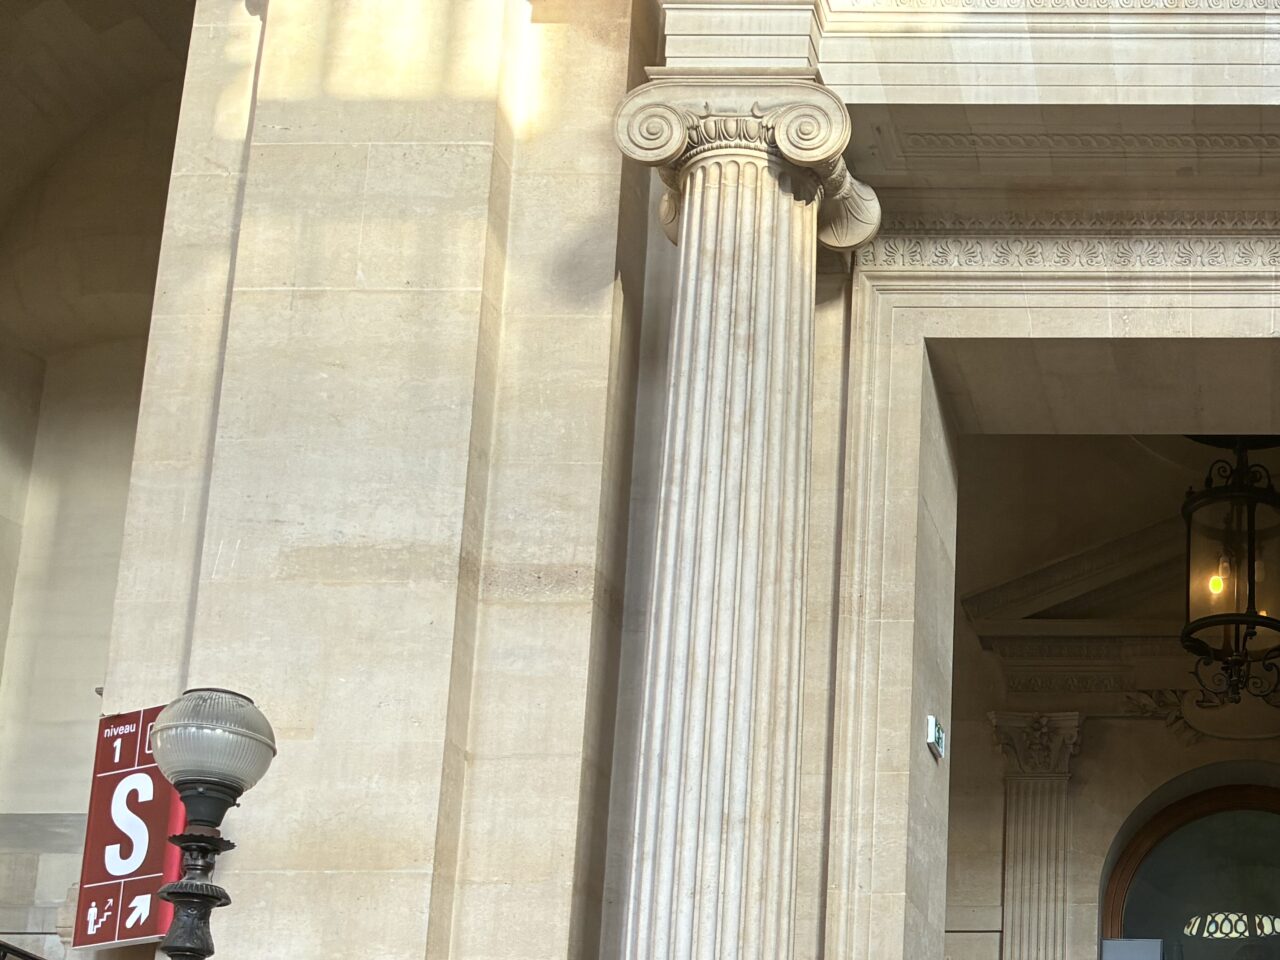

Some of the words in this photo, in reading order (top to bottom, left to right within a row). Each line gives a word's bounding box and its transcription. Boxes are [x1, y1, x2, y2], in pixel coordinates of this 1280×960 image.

[104, 722, 136, 738] niveau
[113, 738, 122, 763] 1
[104, 772, 154, 876] S
